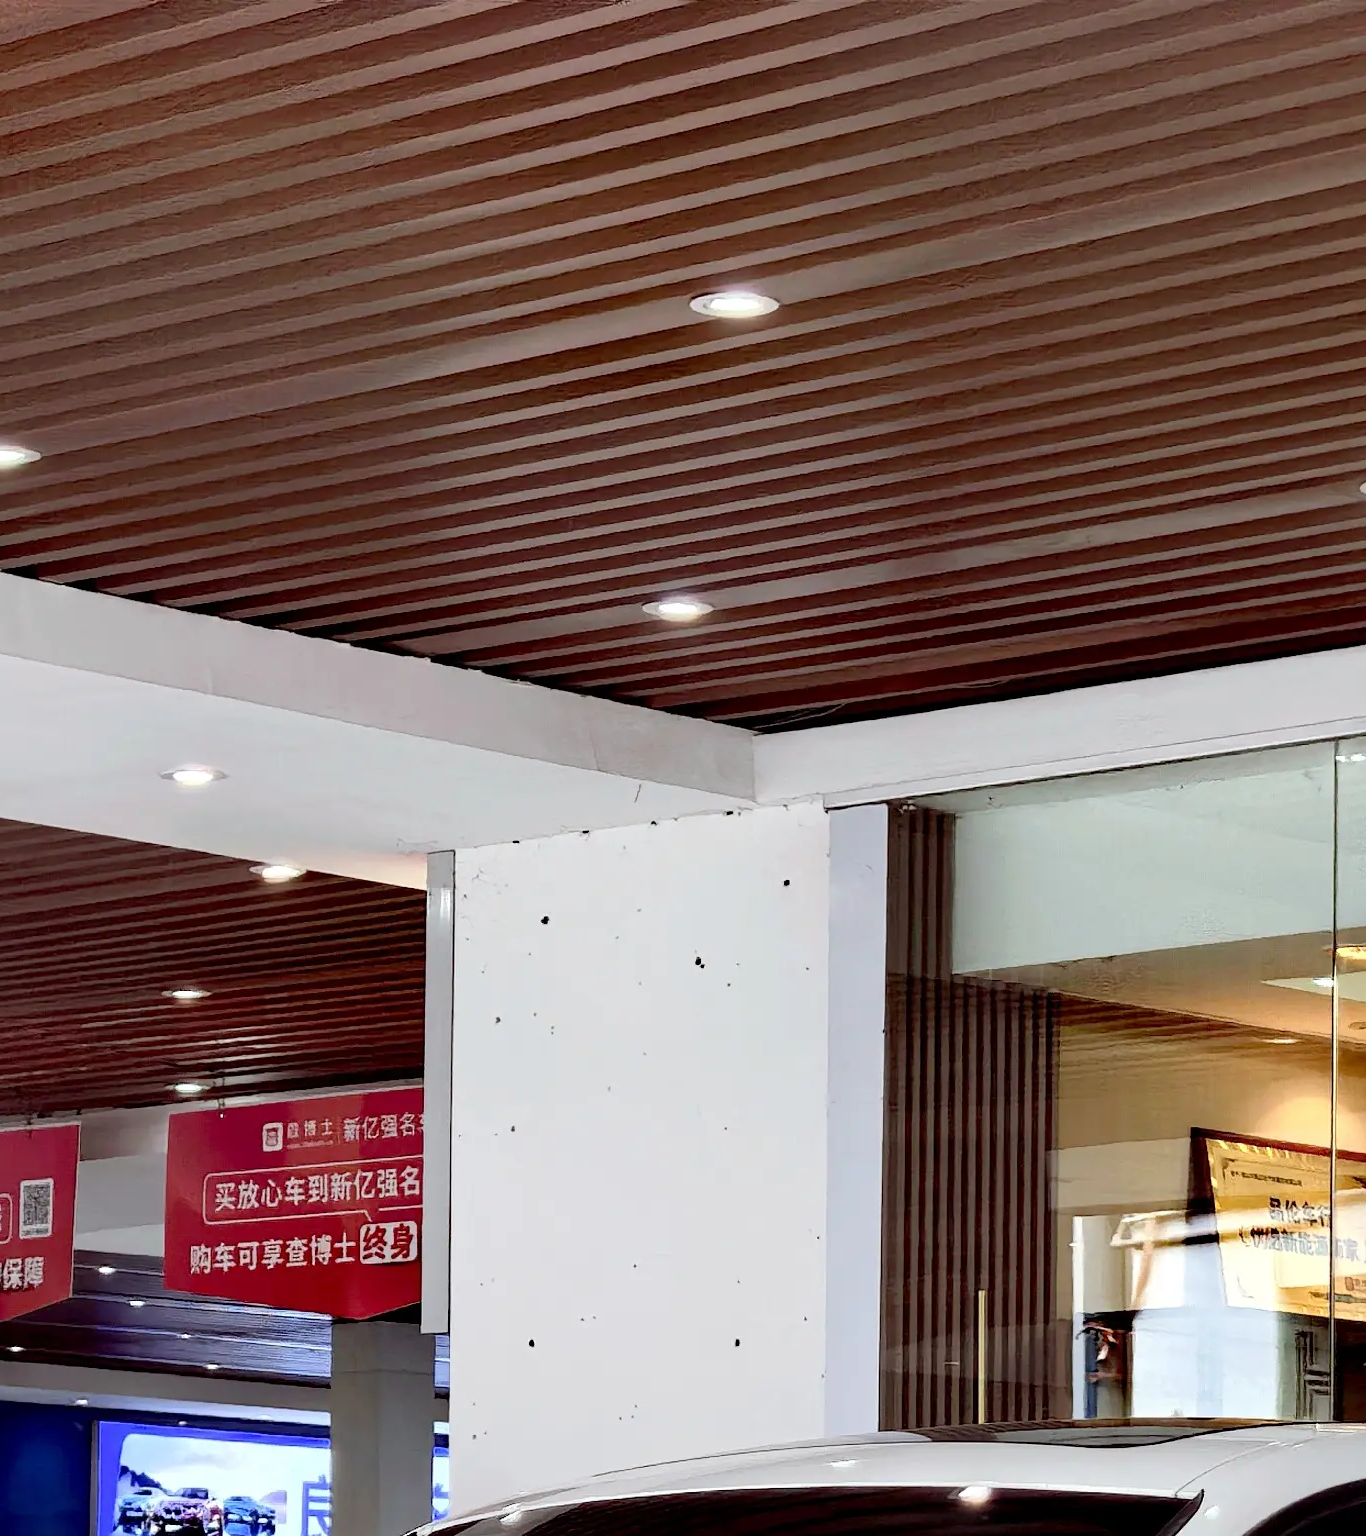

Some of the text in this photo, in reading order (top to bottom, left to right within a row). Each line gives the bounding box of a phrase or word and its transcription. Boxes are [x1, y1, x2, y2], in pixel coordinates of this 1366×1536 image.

[343, 1112, 424, 1143] 新亿强名
[214, 1165, 421, 1212] 买放心车到新亿强名
[190, 1223, 417, 1275] 购车可享查博士终身
